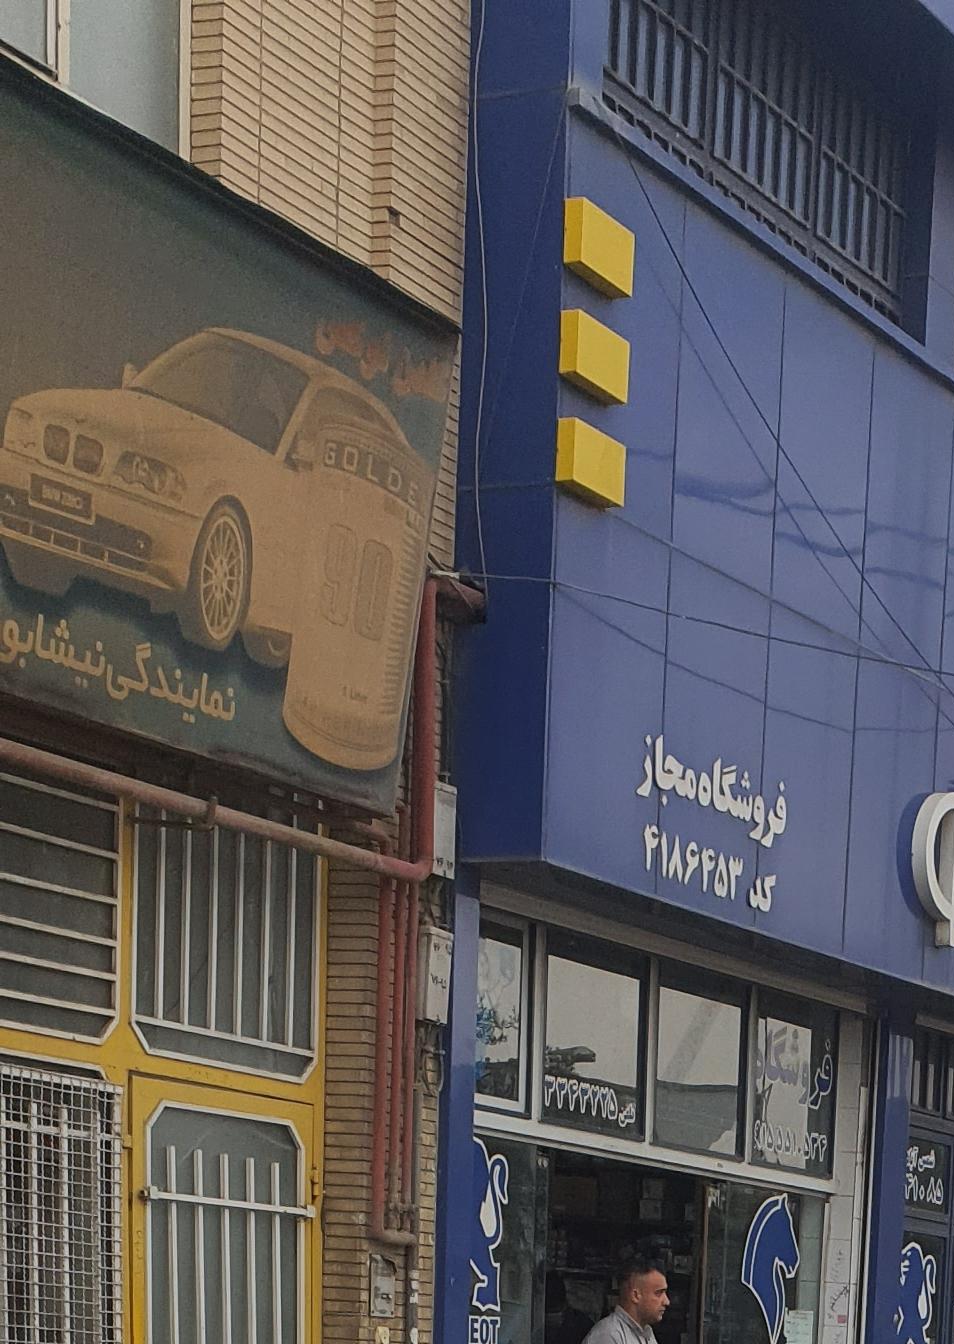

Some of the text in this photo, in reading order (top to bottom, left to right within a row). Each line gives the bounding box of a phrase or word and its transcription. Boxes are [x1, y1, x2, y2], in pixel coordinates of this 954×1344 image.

[106, 642, 237, 725] نمایندگی
[635, 734, 788, 849] فروشگاه مجاز
[643, 822, 777, 913] کد ۴۱۸۶۴۵۳
